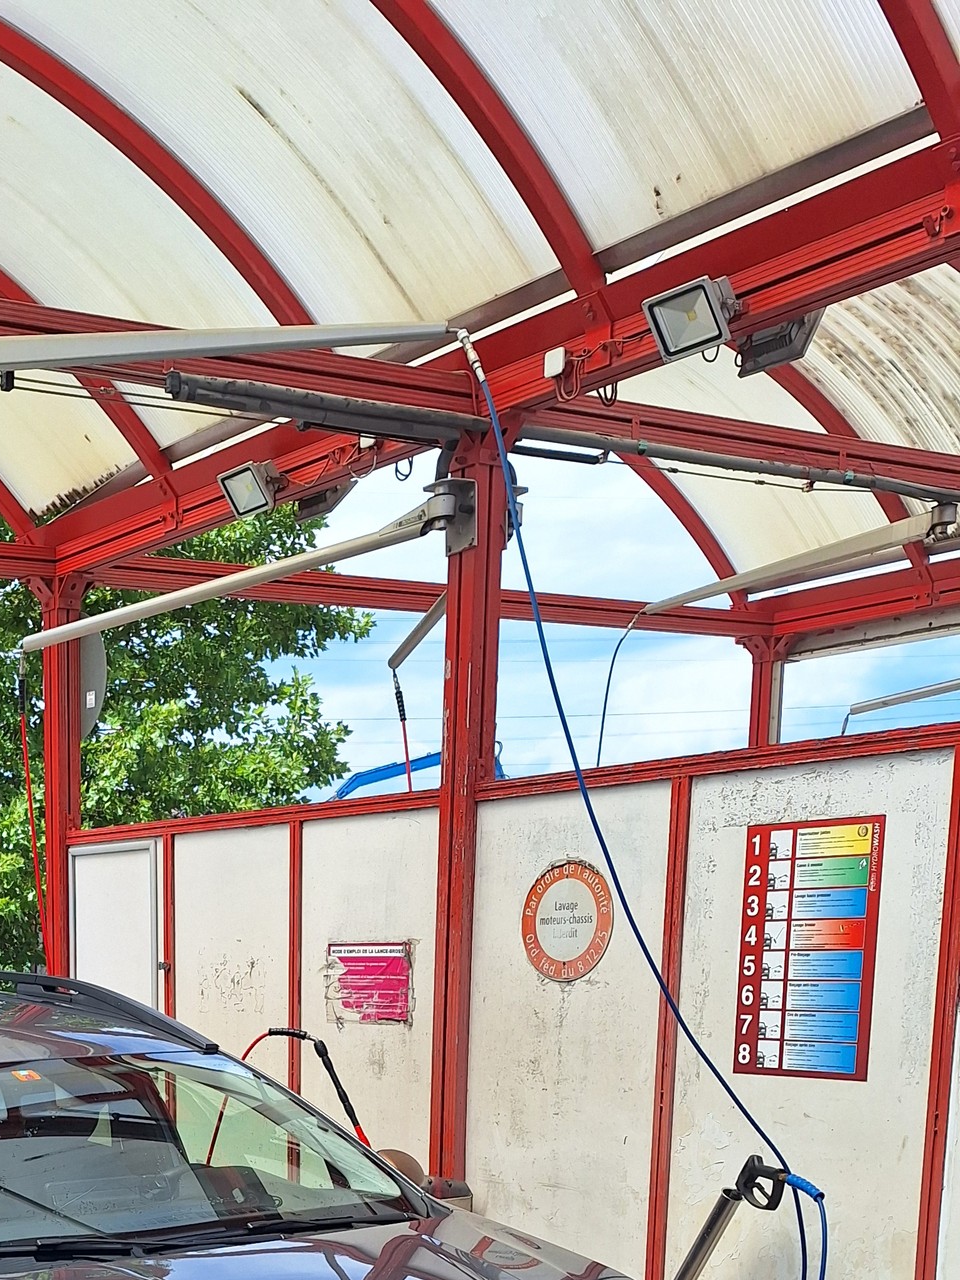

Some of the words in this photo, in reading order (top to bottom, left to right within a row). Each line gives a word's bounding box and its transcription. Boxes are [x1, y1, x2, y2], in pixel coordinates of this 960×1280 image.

[751, 834, 761, 856] 1
[870, 822, 881, 871] HYDROWASH
[748, 865, 762, 886] 2
[525, 895, 538, 916] Par
[536, 868, 560, 893] ordre
[563, 863, 575, 875] de
[554, 901, 579, 913] Lavage
[746, 895, 759, 917] 3
[552, 927, 578, 939] iterdit
[744, 925, 758, 946] 4
[525, 934, 540, 961] Ord.
[540, 958, 558, 977] féd.
[561, 966, 575, 977] du
[742, 955, 756, 976] 5
[741, 985, 754, 1006] 6
[739, 1014, 753, 1035] 7
[737, 1043, 751, 1065] 8
